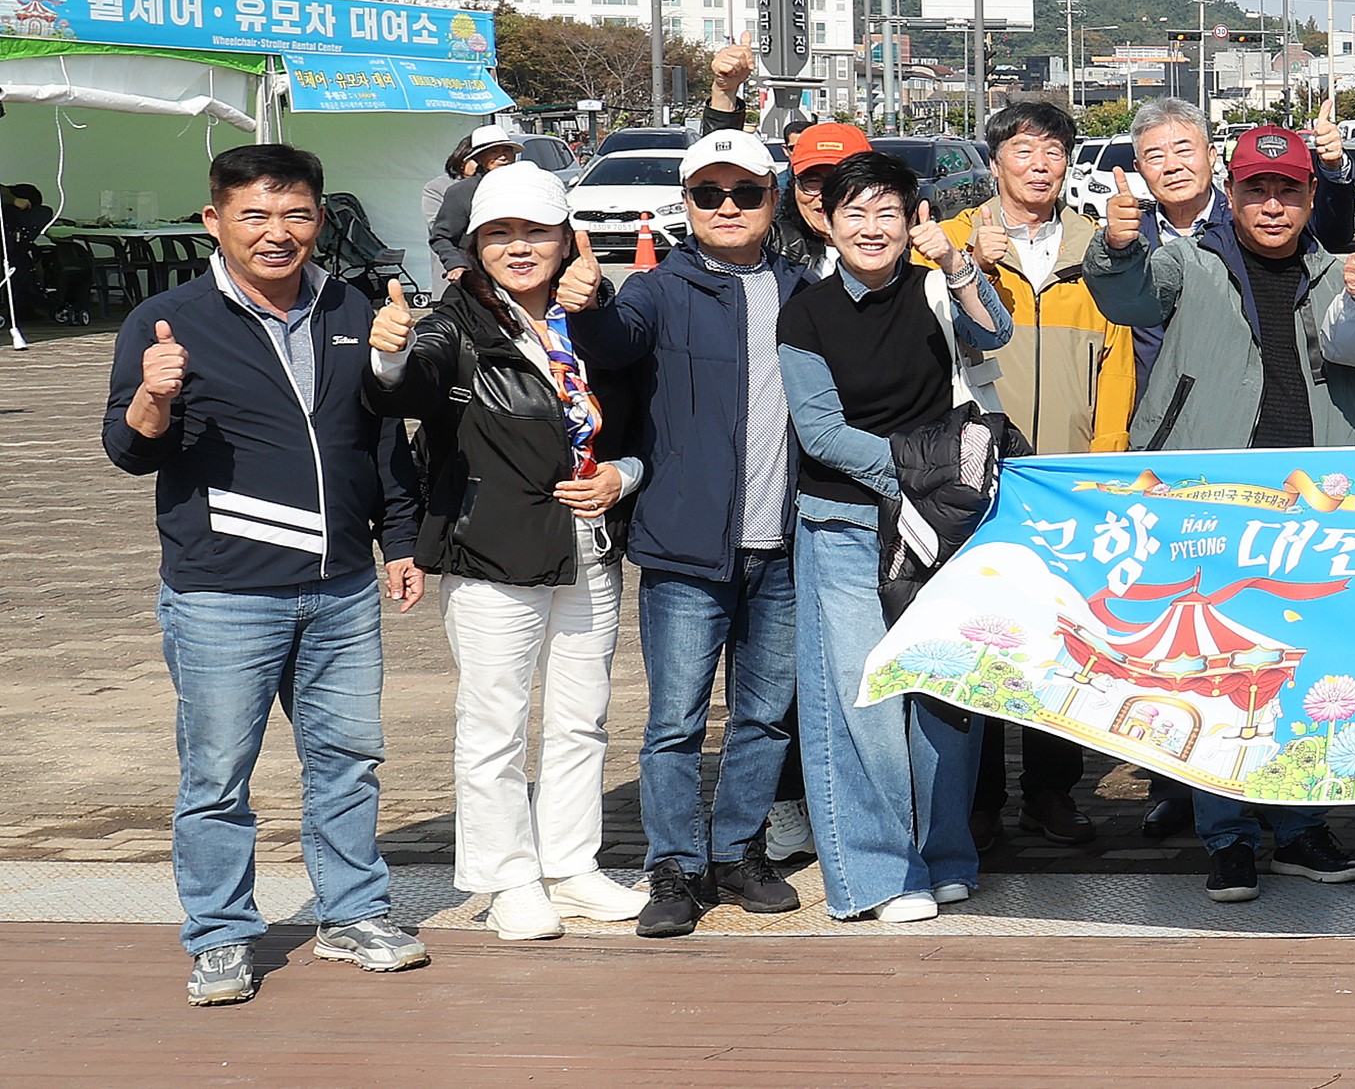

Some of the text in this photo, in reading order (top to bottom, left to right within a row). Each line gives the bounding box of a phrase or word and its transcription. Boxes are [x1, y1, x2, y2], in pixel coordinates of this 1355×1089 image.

[350, 7, 439, 45] 대여소
[291, 40, 317, 52] Rental
[317, 42, 343, 53] Center
[1186, 489, 1239, 502] 대한민국
[1240, 489, 1291, 509] 국향대전
[1180, 513, 1219, 535] HAM
[1169, 535, 1228, 562] PYEONG
